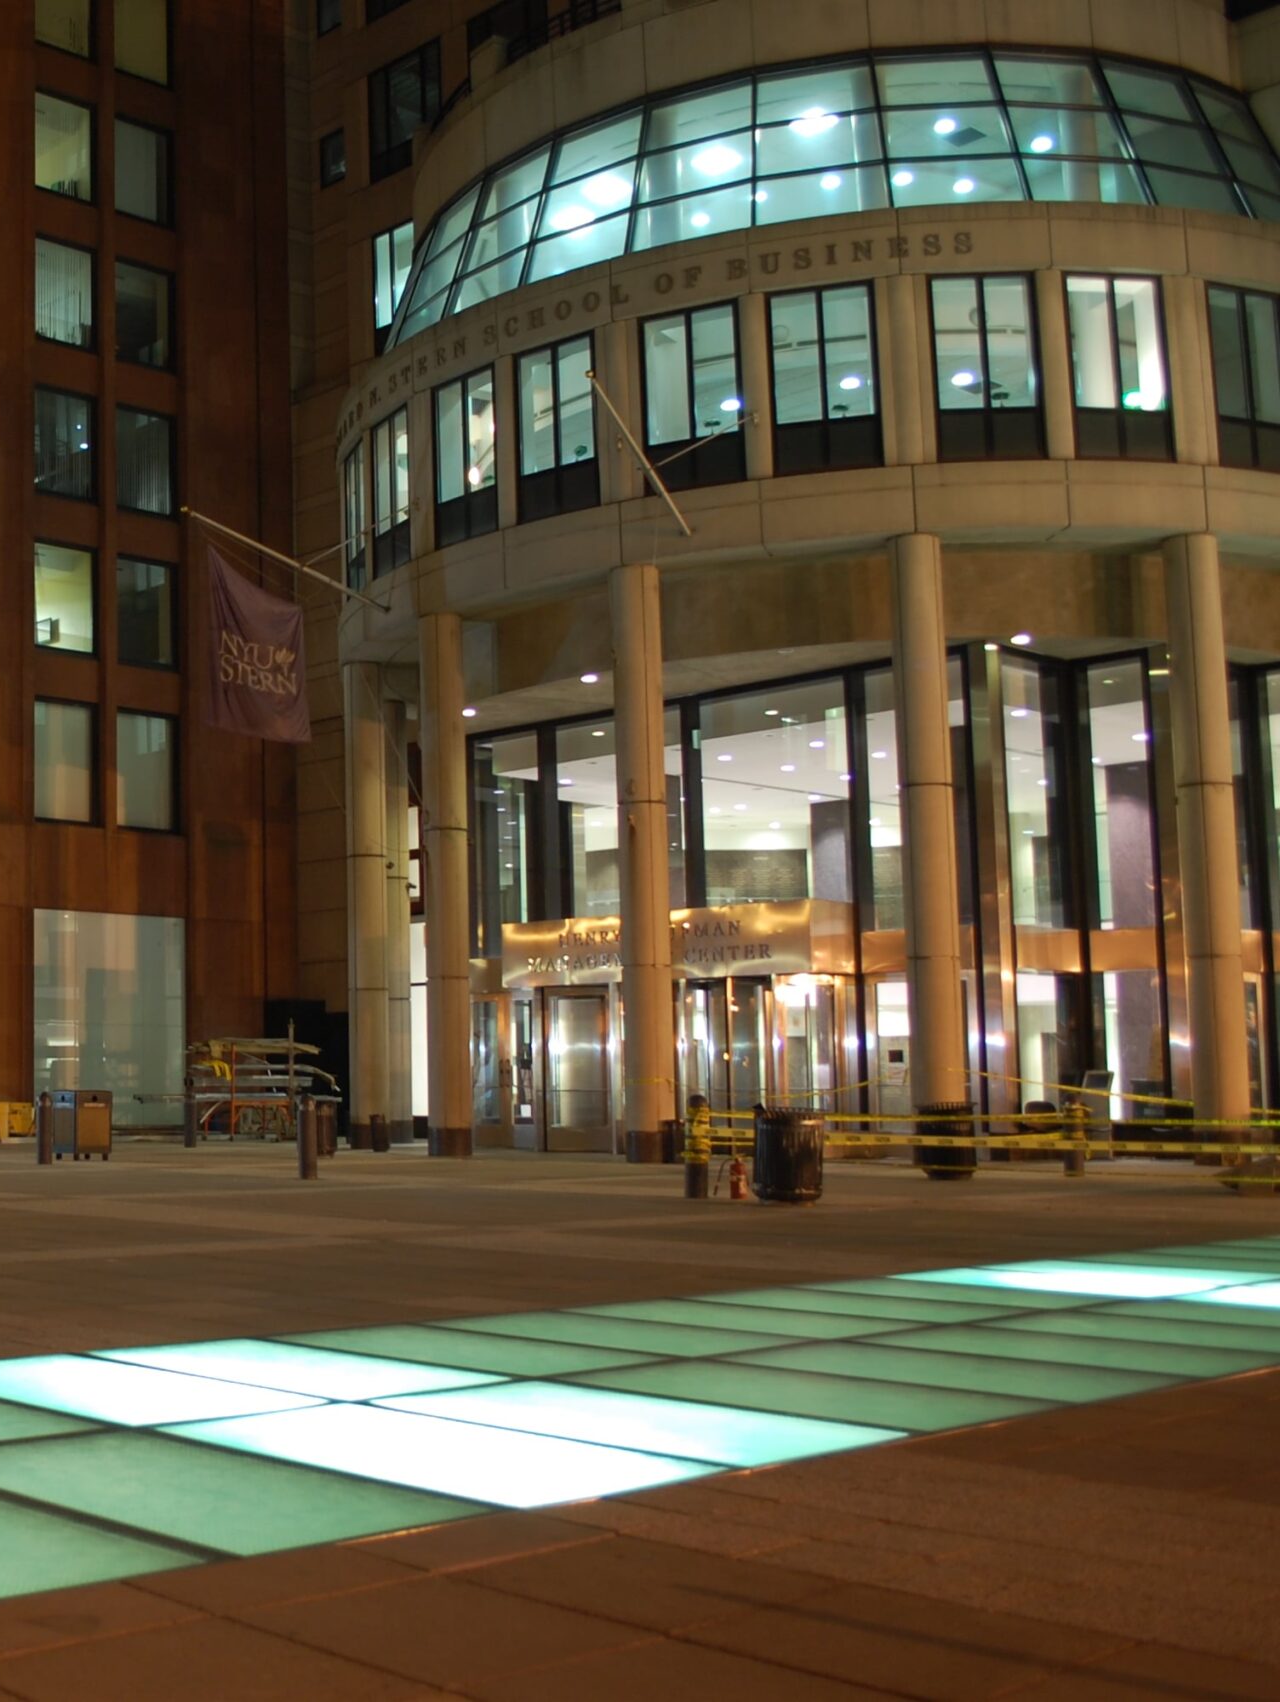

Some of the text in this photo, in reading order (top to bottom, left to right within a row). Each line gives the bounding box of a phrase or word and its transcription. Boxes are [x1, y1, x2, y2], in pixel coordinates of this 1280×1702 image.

[388, 336, 467, 394] STERN
[483, 283, 631, 345] SCHOOL
[653, 265, 703, 296] OF
[726, 231, 975, 281] BUSINESS
[218, 629, 274, 670] NYU
[220, 654, 297, 696] STERN
[558, 929, 621, 948] HENRY
[684, 943, 772, 964] CENTER
